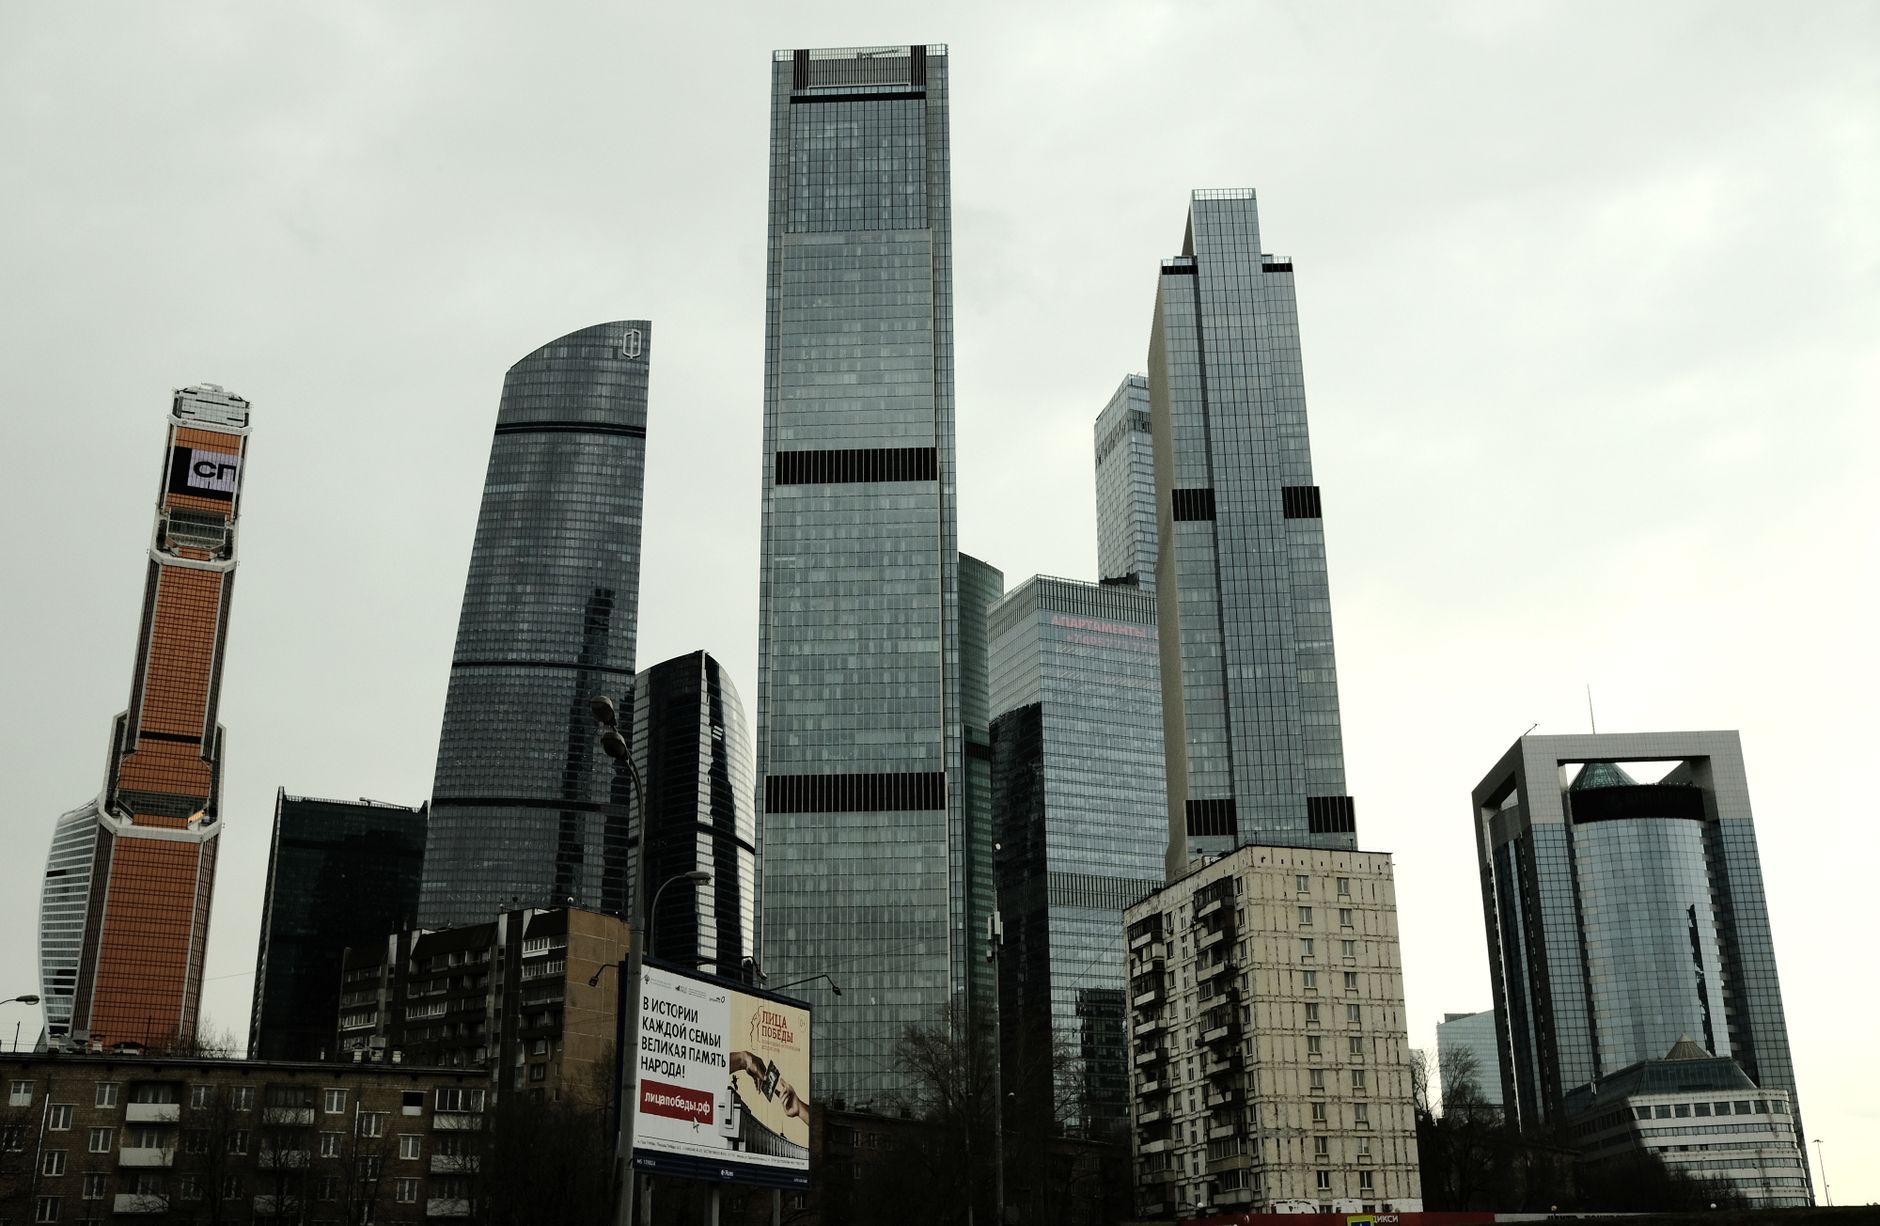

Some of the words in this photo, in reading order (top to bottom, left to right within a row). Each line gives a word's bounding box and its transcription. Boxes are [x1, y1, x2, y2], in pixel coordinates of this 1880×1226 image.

[643, 996, 649, 1011] В
[652, 998, 698, 1023] ИСТОРИИ
[762, 1011, 787, 1029] ЛИЦА
[642, 1016, 687, 1040] КАЖДОЙ
[689, 1028, 721, 1048] СЕМЬИ
[762, 1025, 794, 1044] ПОБЕДЫ
[641, 1036, 687, 1059] ВЕЛИКАЯ
[689, 1047, 727, 1068] ПАМЯТЬ
[640, 1056, 685, 1079] НАРОДА!
[644, 1092, 710, 1116] лицапобеды.рф
